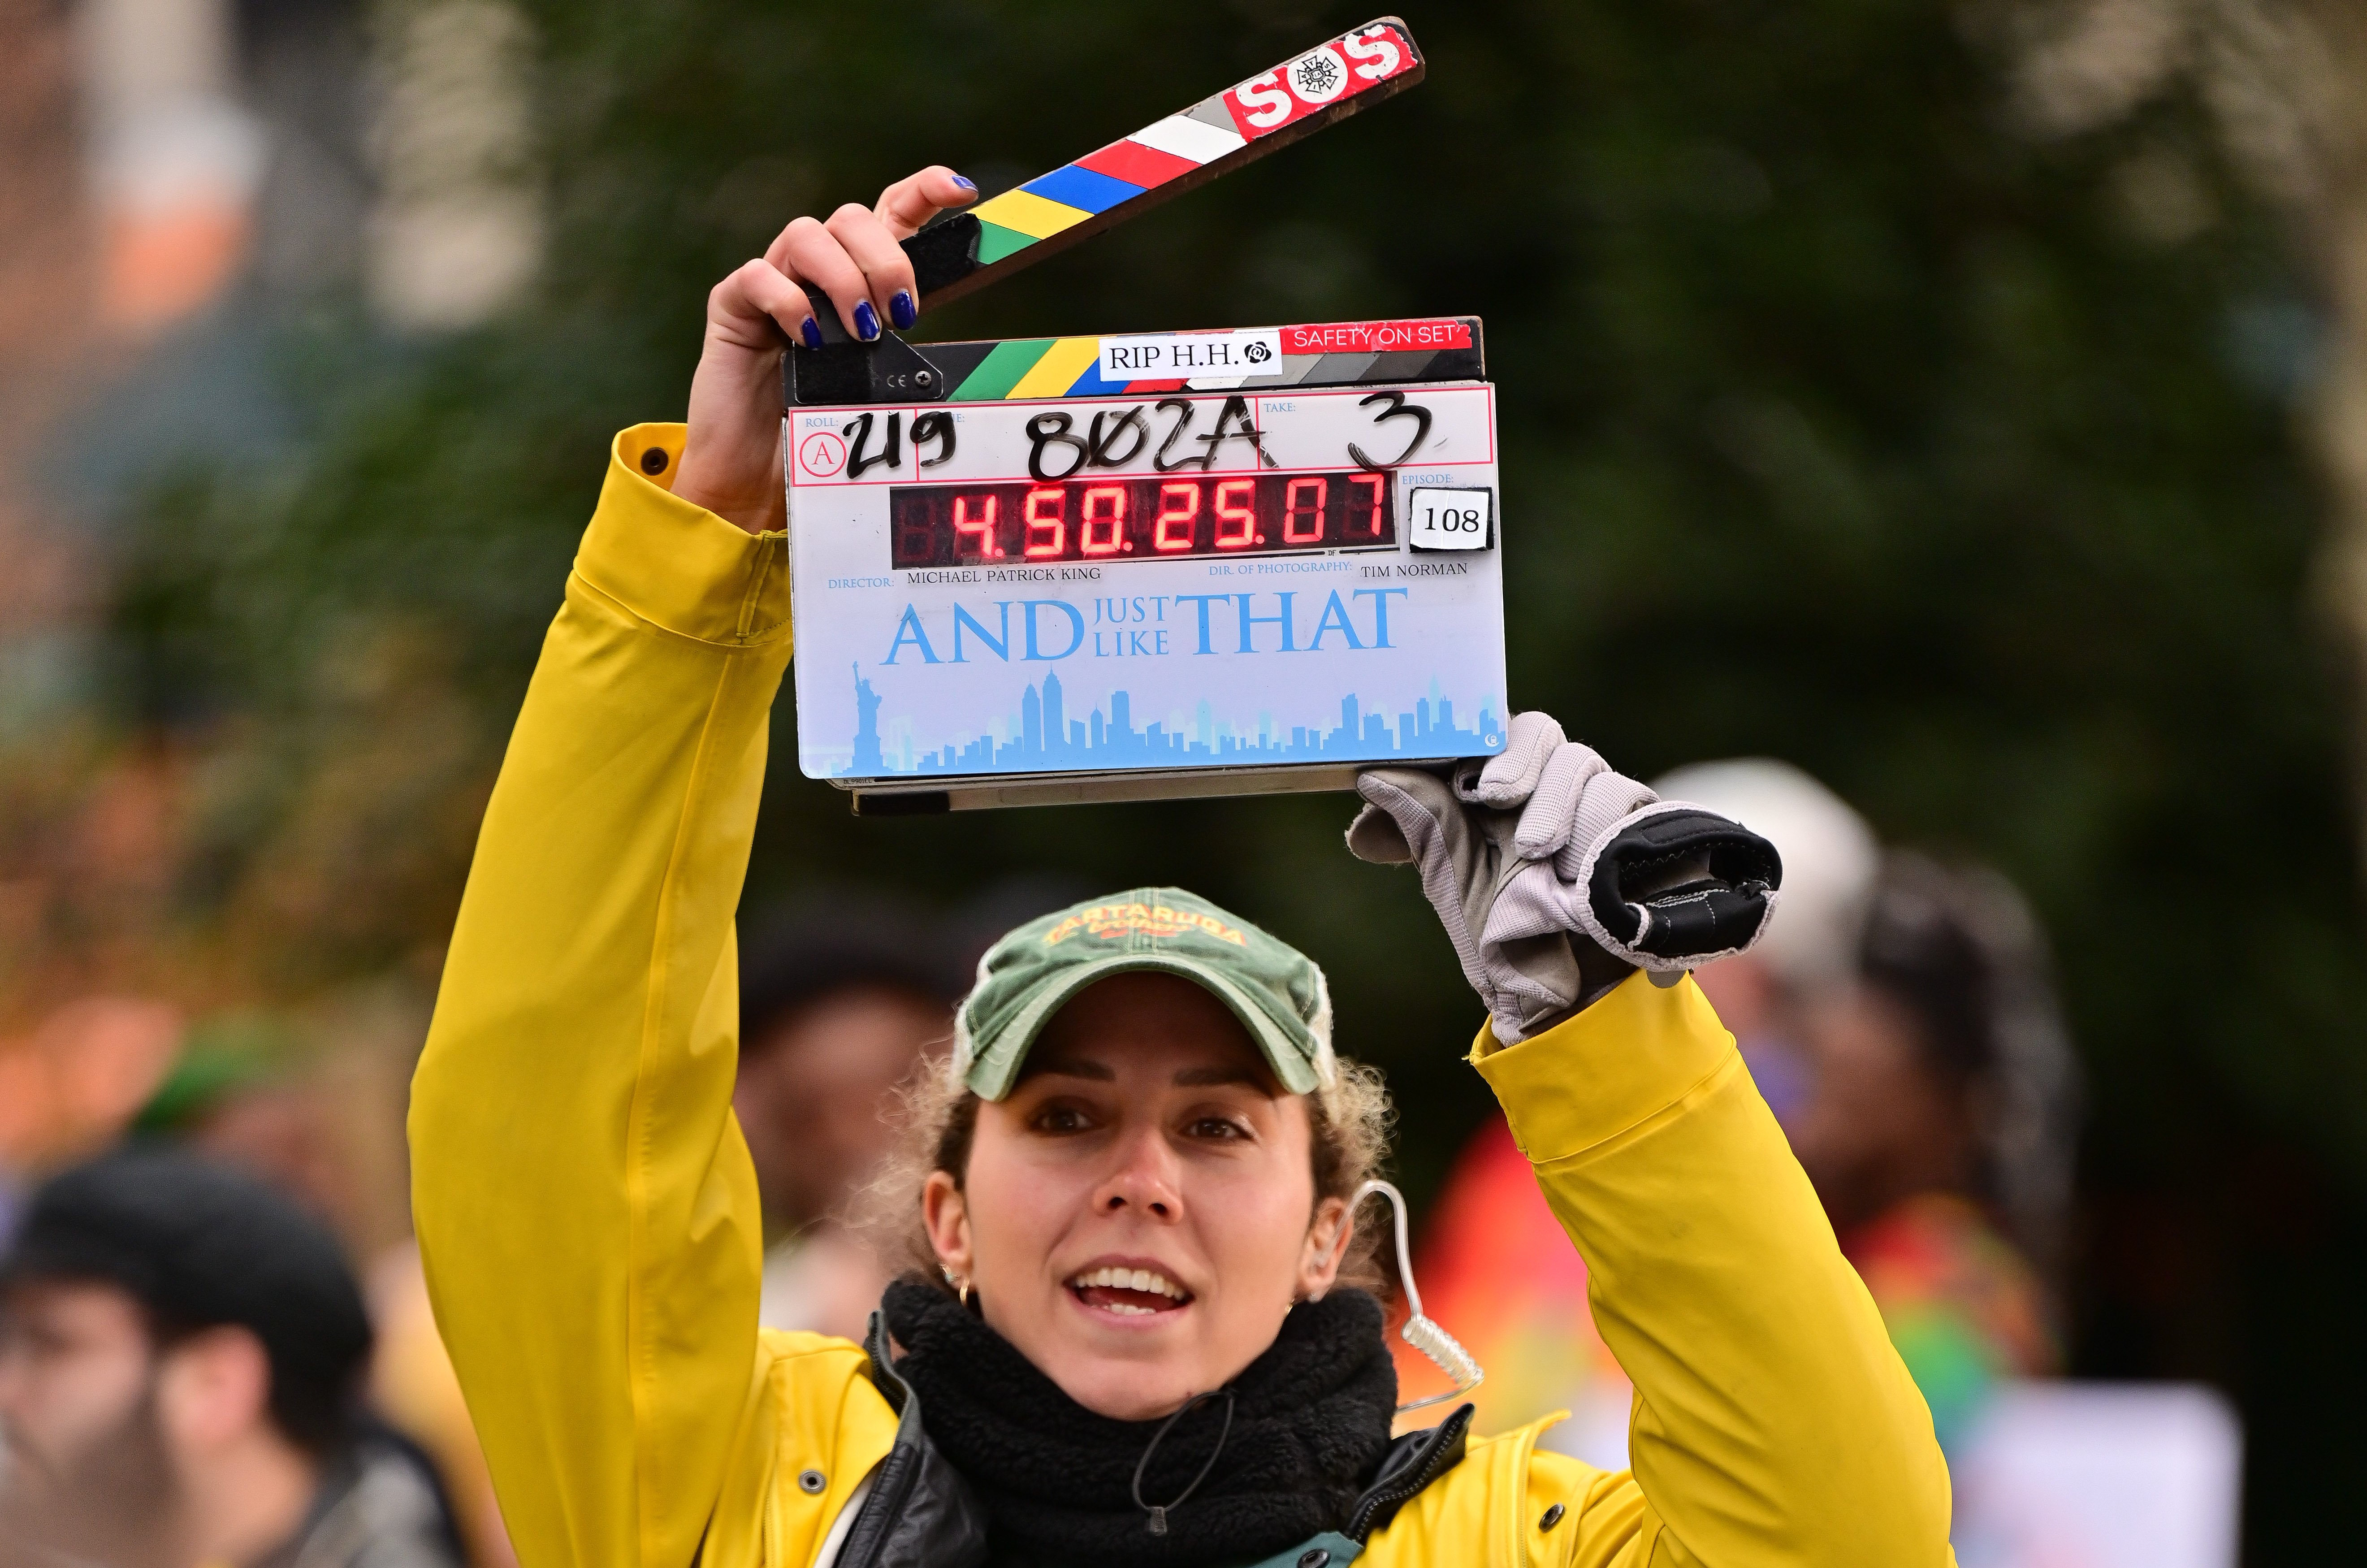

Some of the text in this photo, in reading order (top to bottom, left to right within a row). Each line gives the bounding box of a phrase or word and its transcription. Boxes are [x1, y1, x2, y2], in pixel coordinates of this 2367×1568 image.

[1294, 325, 1456, 347] SAFETY ON SET
[1110, 343, 1239, 369] RIP H.H.
[1264, 403, 1296, 413] TAKE:
[805, 418, 839, 427] ROLL:
[1348, 391, 1433, 471] 3
[811, 441, 835, 465] A
[1402, 474, 1454, 485] EPISODE:
[1424, 507, 1479, 533] 108
[908, 567, 1101, 584] MICHAEL PATRICK KING
[1238, 565, 1254, 575] OF
[1258, 562, 1352, 574] PHOTOGRAPHY:
[1361, 563, 1467, 577] TIM NORMAN
[829, 577, 894, 588] DIRECTOR:
[1093, 596, 1170, 626] JUST
[1175, 587, 1408, 655] THAT
[879, 599, 1085, 665] AND
[1094, 630, 1169, 657] LIKE
